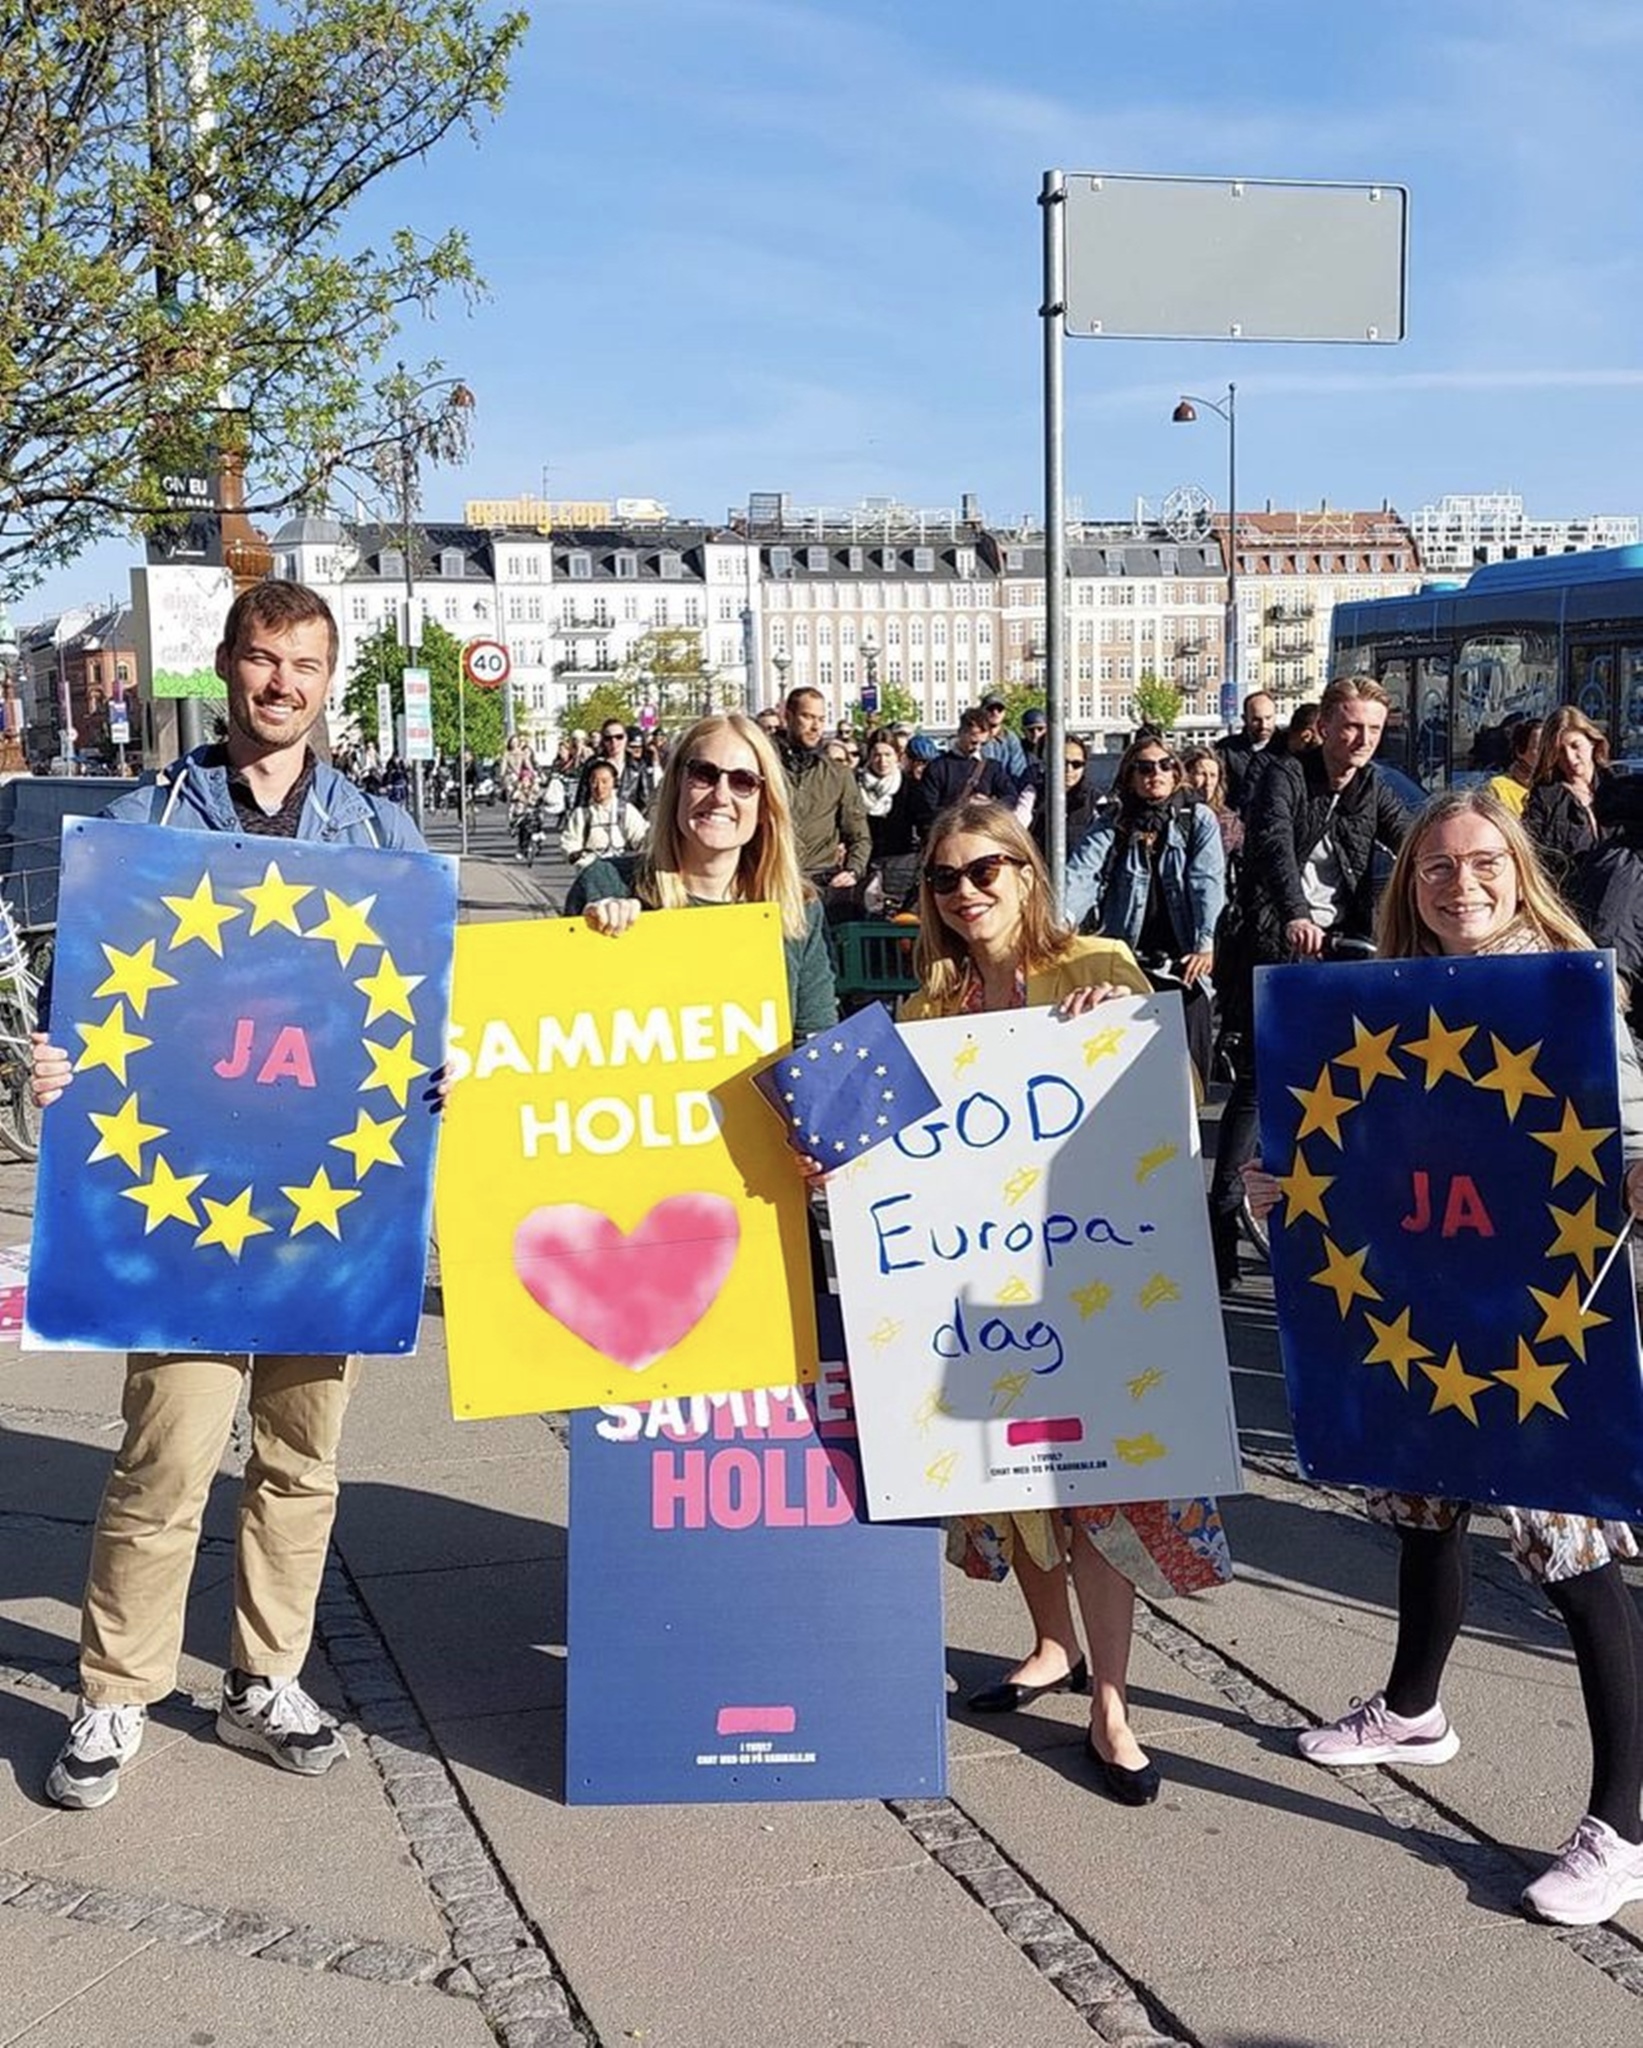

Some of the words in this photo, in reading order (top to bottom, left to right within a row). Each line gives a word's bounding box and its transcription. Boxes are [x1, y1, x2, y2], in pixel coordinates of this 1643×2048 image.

[189, 478, 208, 495] EU
[474, 655, 502, 672] 40
[213, 1019, 317, 1088] JA
[447, 1000, 778, 1082] SAMMEN
[520, 1090, 724, 1158] HOLD
[870, 1193, 1155, 1275] Europa-
[1400, 1171, 1495, 1238] JA
[933, 1297, 1064, 1375] dag
[652, 1447, 858, 1529] HOLD
